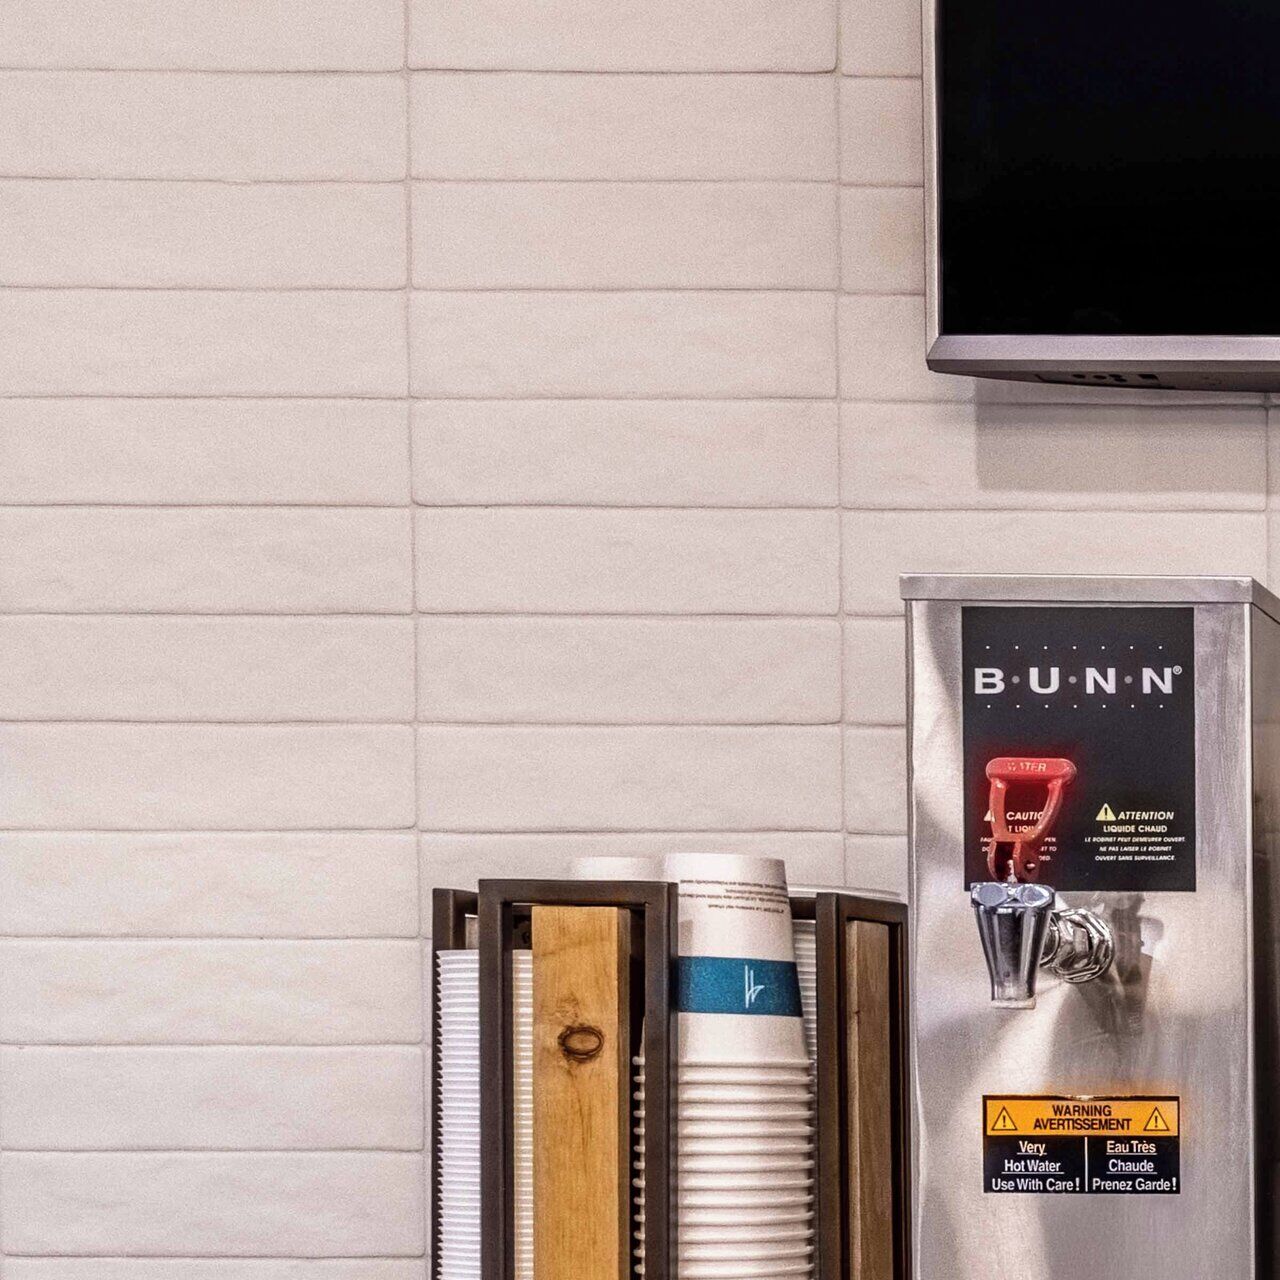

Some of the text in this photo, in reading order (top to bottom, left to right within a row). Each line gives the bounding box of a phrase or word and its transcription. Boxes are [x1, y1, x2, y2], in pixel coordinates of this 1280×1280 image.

[1118, 811, 1174, 820] ATTENTION
[1103, 825, 1168, 833] LIQUIDE CHAUD
[1052, 1105, 1112, 1117] WARNING
[1033, 1118, 1132, 1131] AVERTISSEMENT
[1019, 1140, 1046, 1156] Very
[1106, 1140, 1157, 1153] Eau Très
[1004, 1159, 1061, 1172] Hot Water
[1109, 1158, 1154, 1172] Chaude
[992, 1178, 1015, 1191] Use
[1017, 1178, 1044, 1191] With
[1092, 1178, 1132, 1191] Prenez
